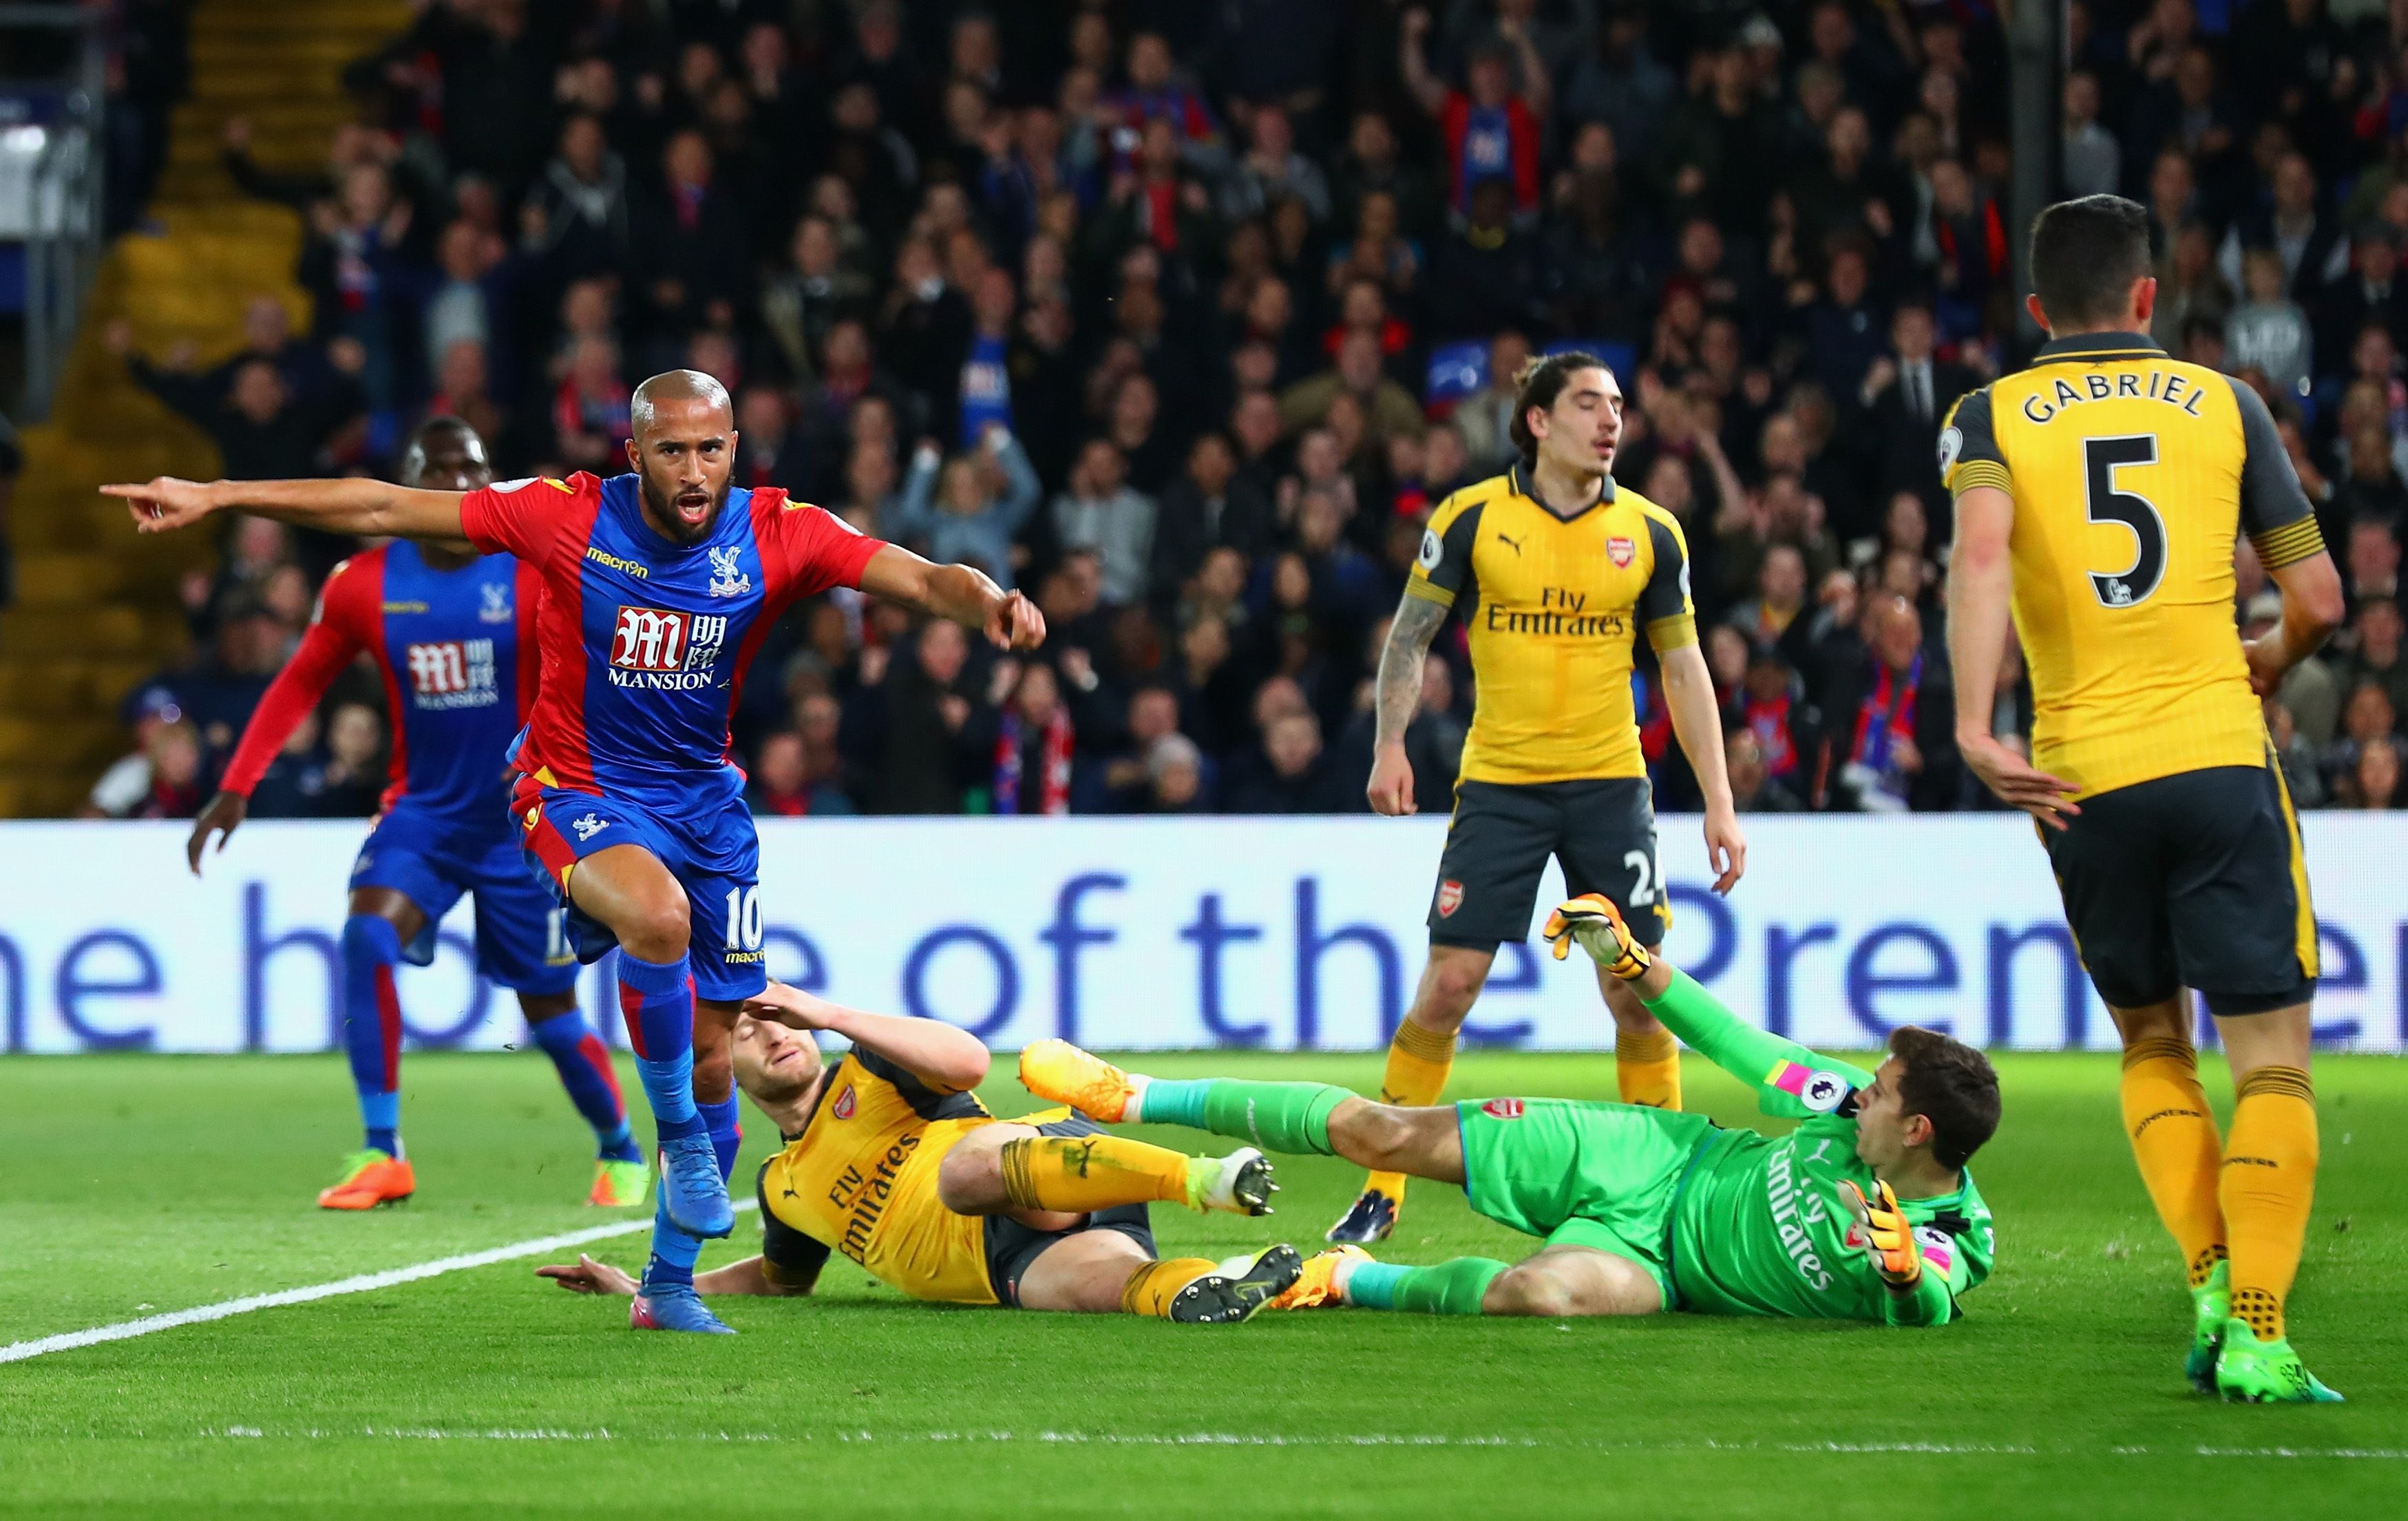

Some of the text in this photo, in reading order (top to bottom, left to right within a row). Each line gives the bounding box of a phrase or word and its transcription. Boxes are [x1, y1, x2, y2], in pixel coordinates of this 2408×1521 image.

[2023, 372, 2206, 423] GABRIEL
[2082, 433, 2168, 608] 5
[587, 546, 648, 579] macron
[1488, 604, 1624, 635] Emirates
[609, 668, 715, 690] MANSION
[724, 885, 763, 950] 10
[900, 873, 1130, 1047] of
[1176, 875, 1542, 1049] the
[838, 1133, 920, 1264] Emirates
